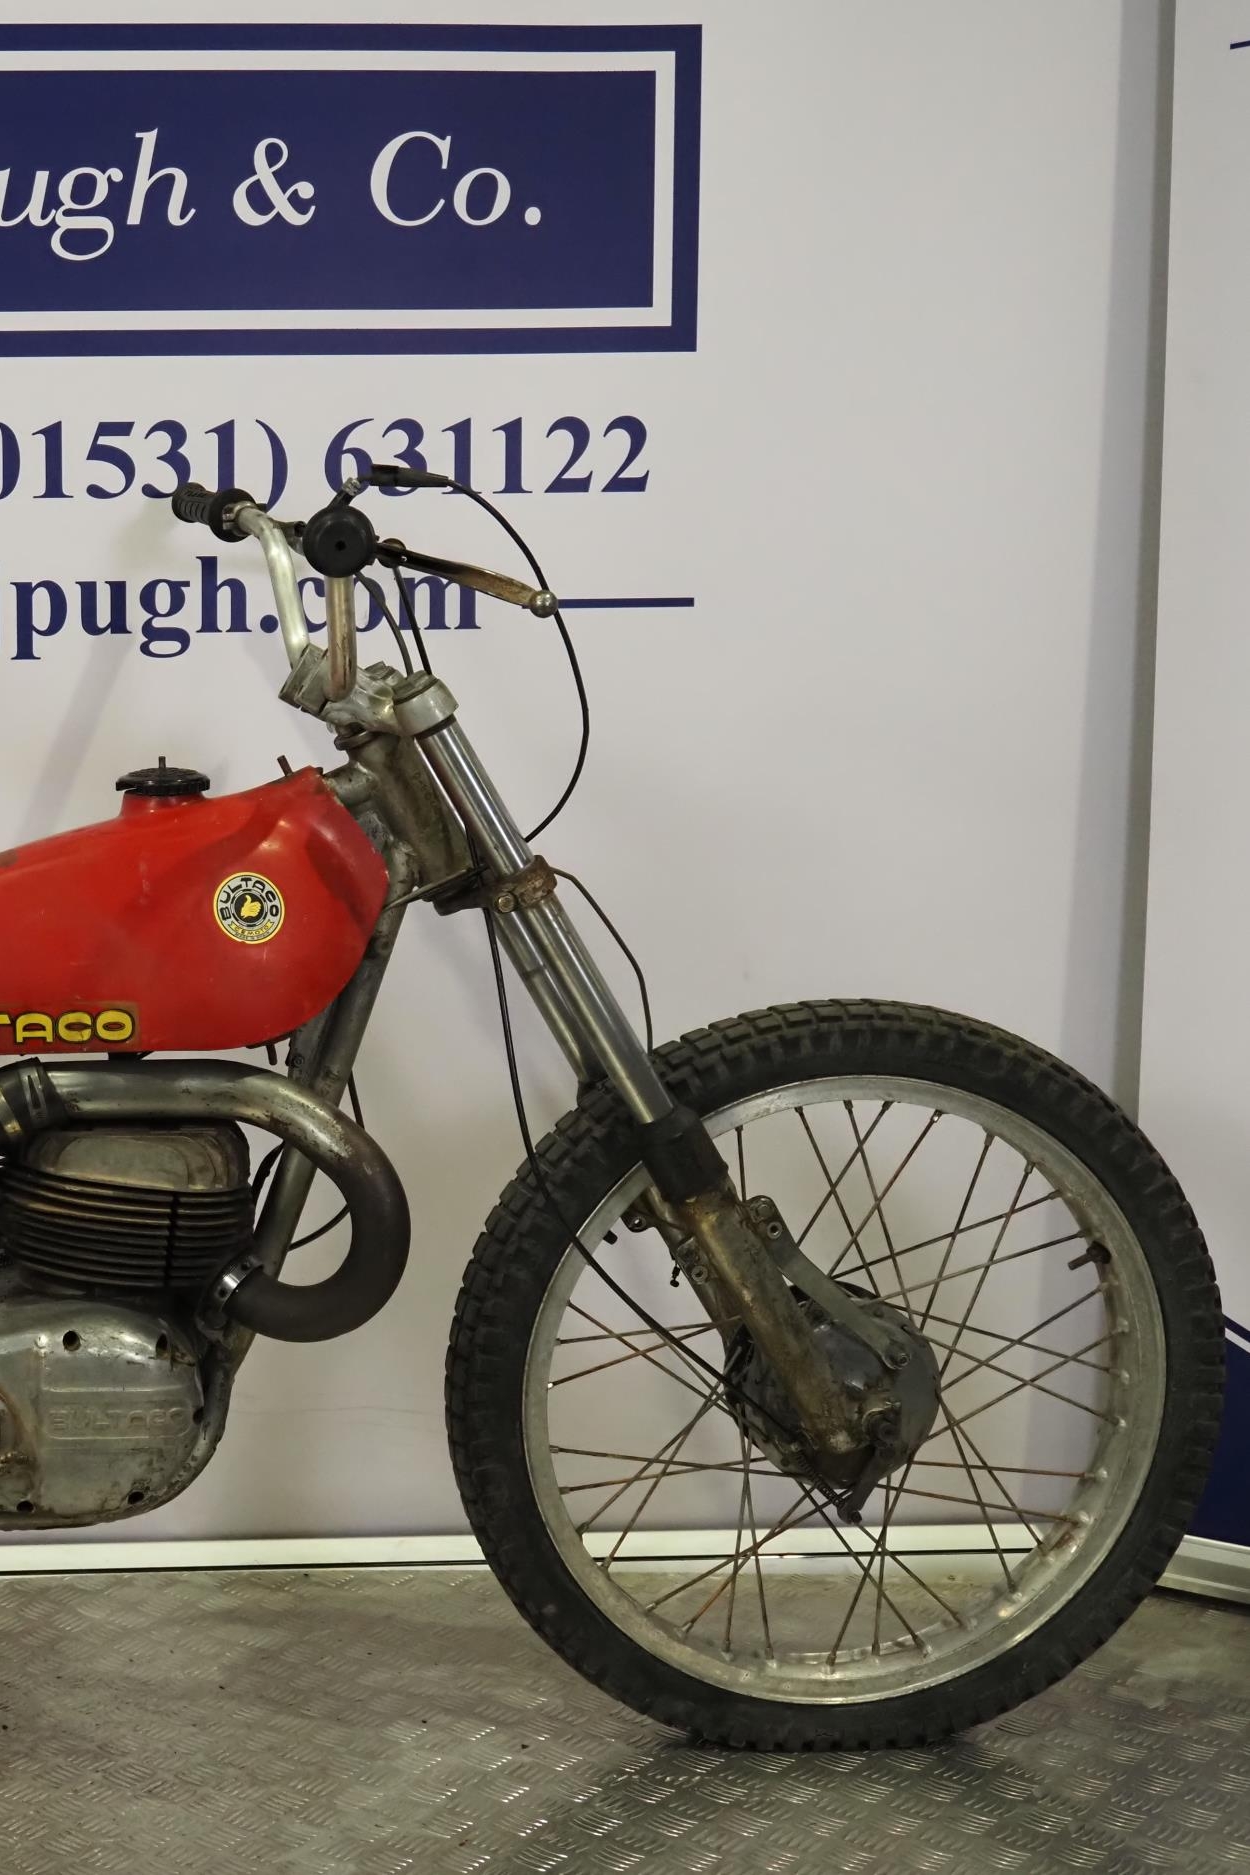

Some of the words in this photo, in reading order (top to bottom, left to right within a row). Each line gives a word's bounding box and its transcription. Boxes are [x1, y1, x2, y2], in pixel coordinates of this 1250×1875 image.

[232, 137, 316, 227] &
[369, 130, 542, 227] Co.
[324, 415, 651, 497] 631122
[219, 877, 279, 921] BULTACO
